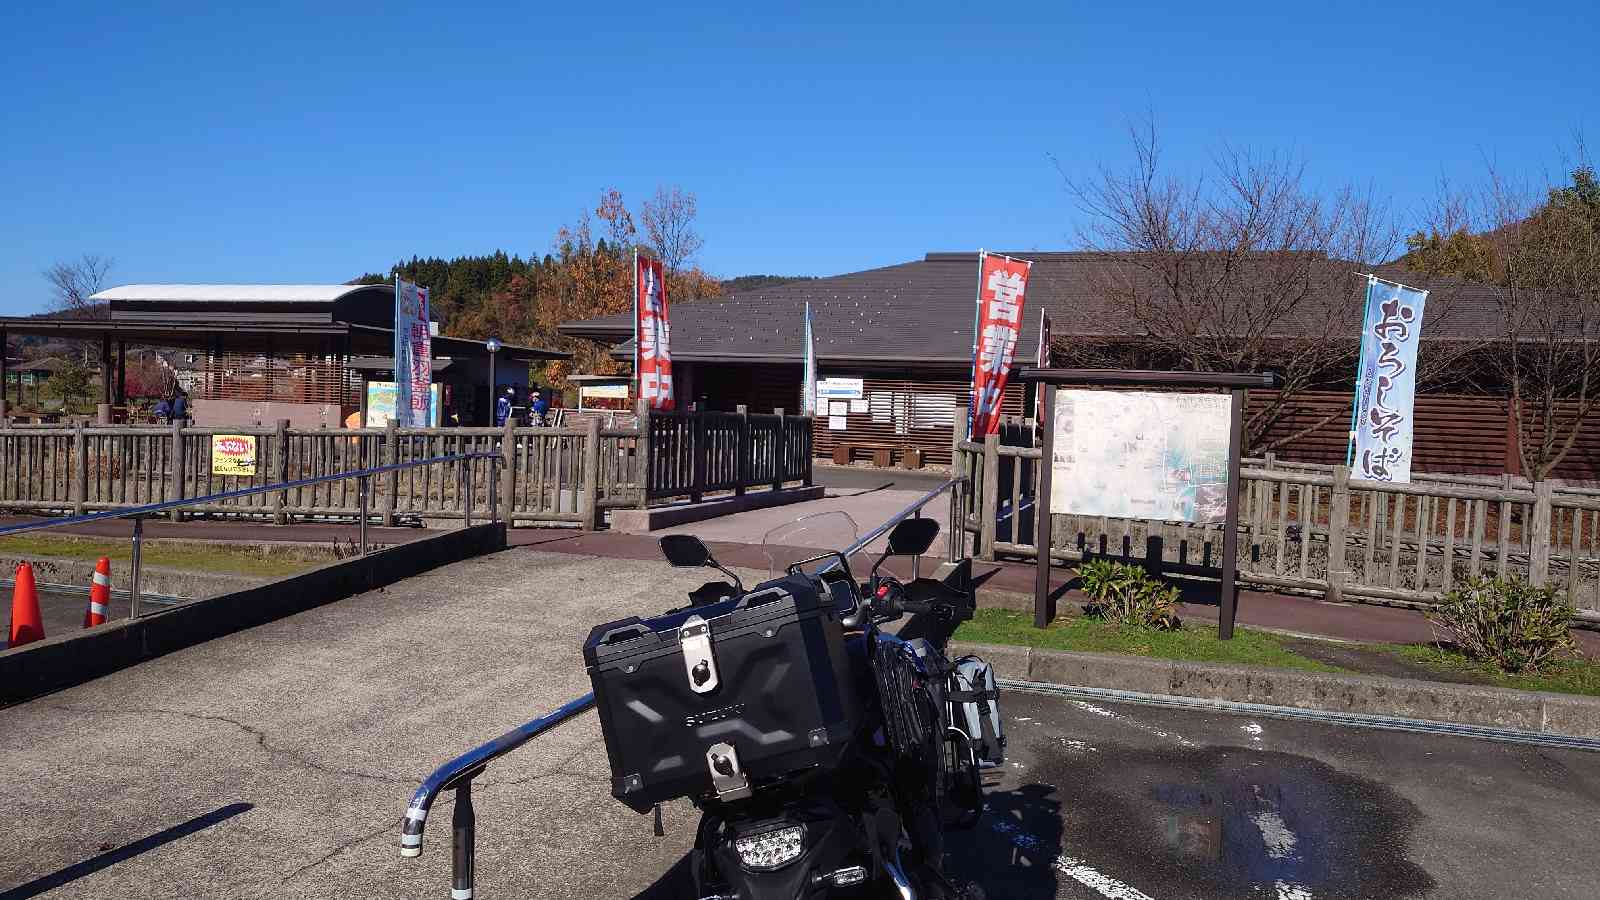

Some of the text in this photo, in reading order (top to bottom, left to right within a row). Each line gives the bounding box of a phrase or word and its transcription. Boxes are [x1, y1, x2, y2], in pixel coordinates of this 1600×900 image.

[977, 269, 1025, 415] 営業中
[1362, 299, 1415, 482] おろしそば
